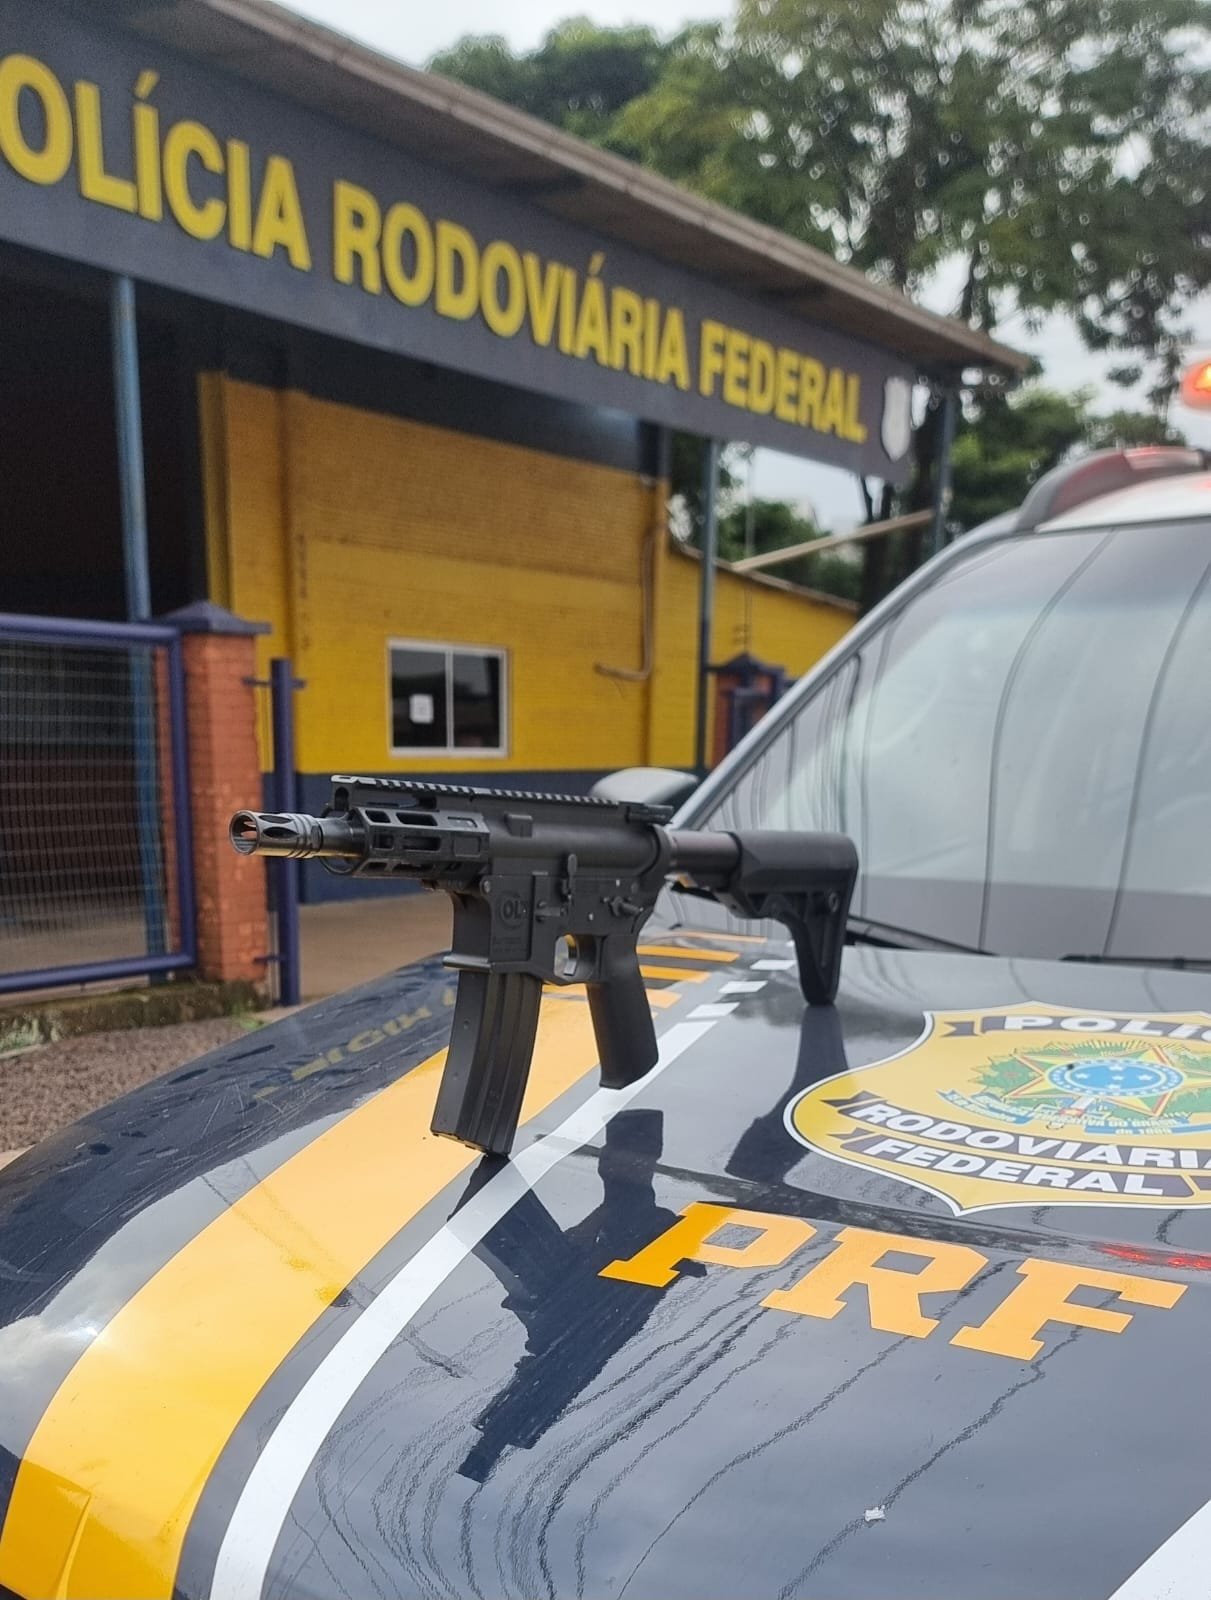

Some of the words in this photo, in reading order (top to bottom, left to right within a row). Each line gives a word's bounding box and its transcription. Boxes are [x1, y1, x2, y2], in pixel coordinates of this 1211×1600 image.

[0, 53, 312, 272] OLÍCIA
[332, 178, 691, 390] RODOVIÁRIA
[701, 318, 868, 444] FEDERAL
[849, 1103, 1211, 1168] RODOVIÁRI
[864, 1138, 1163, 1195] FEDERAL
[597, 1201, 1188, 1361] PRF
